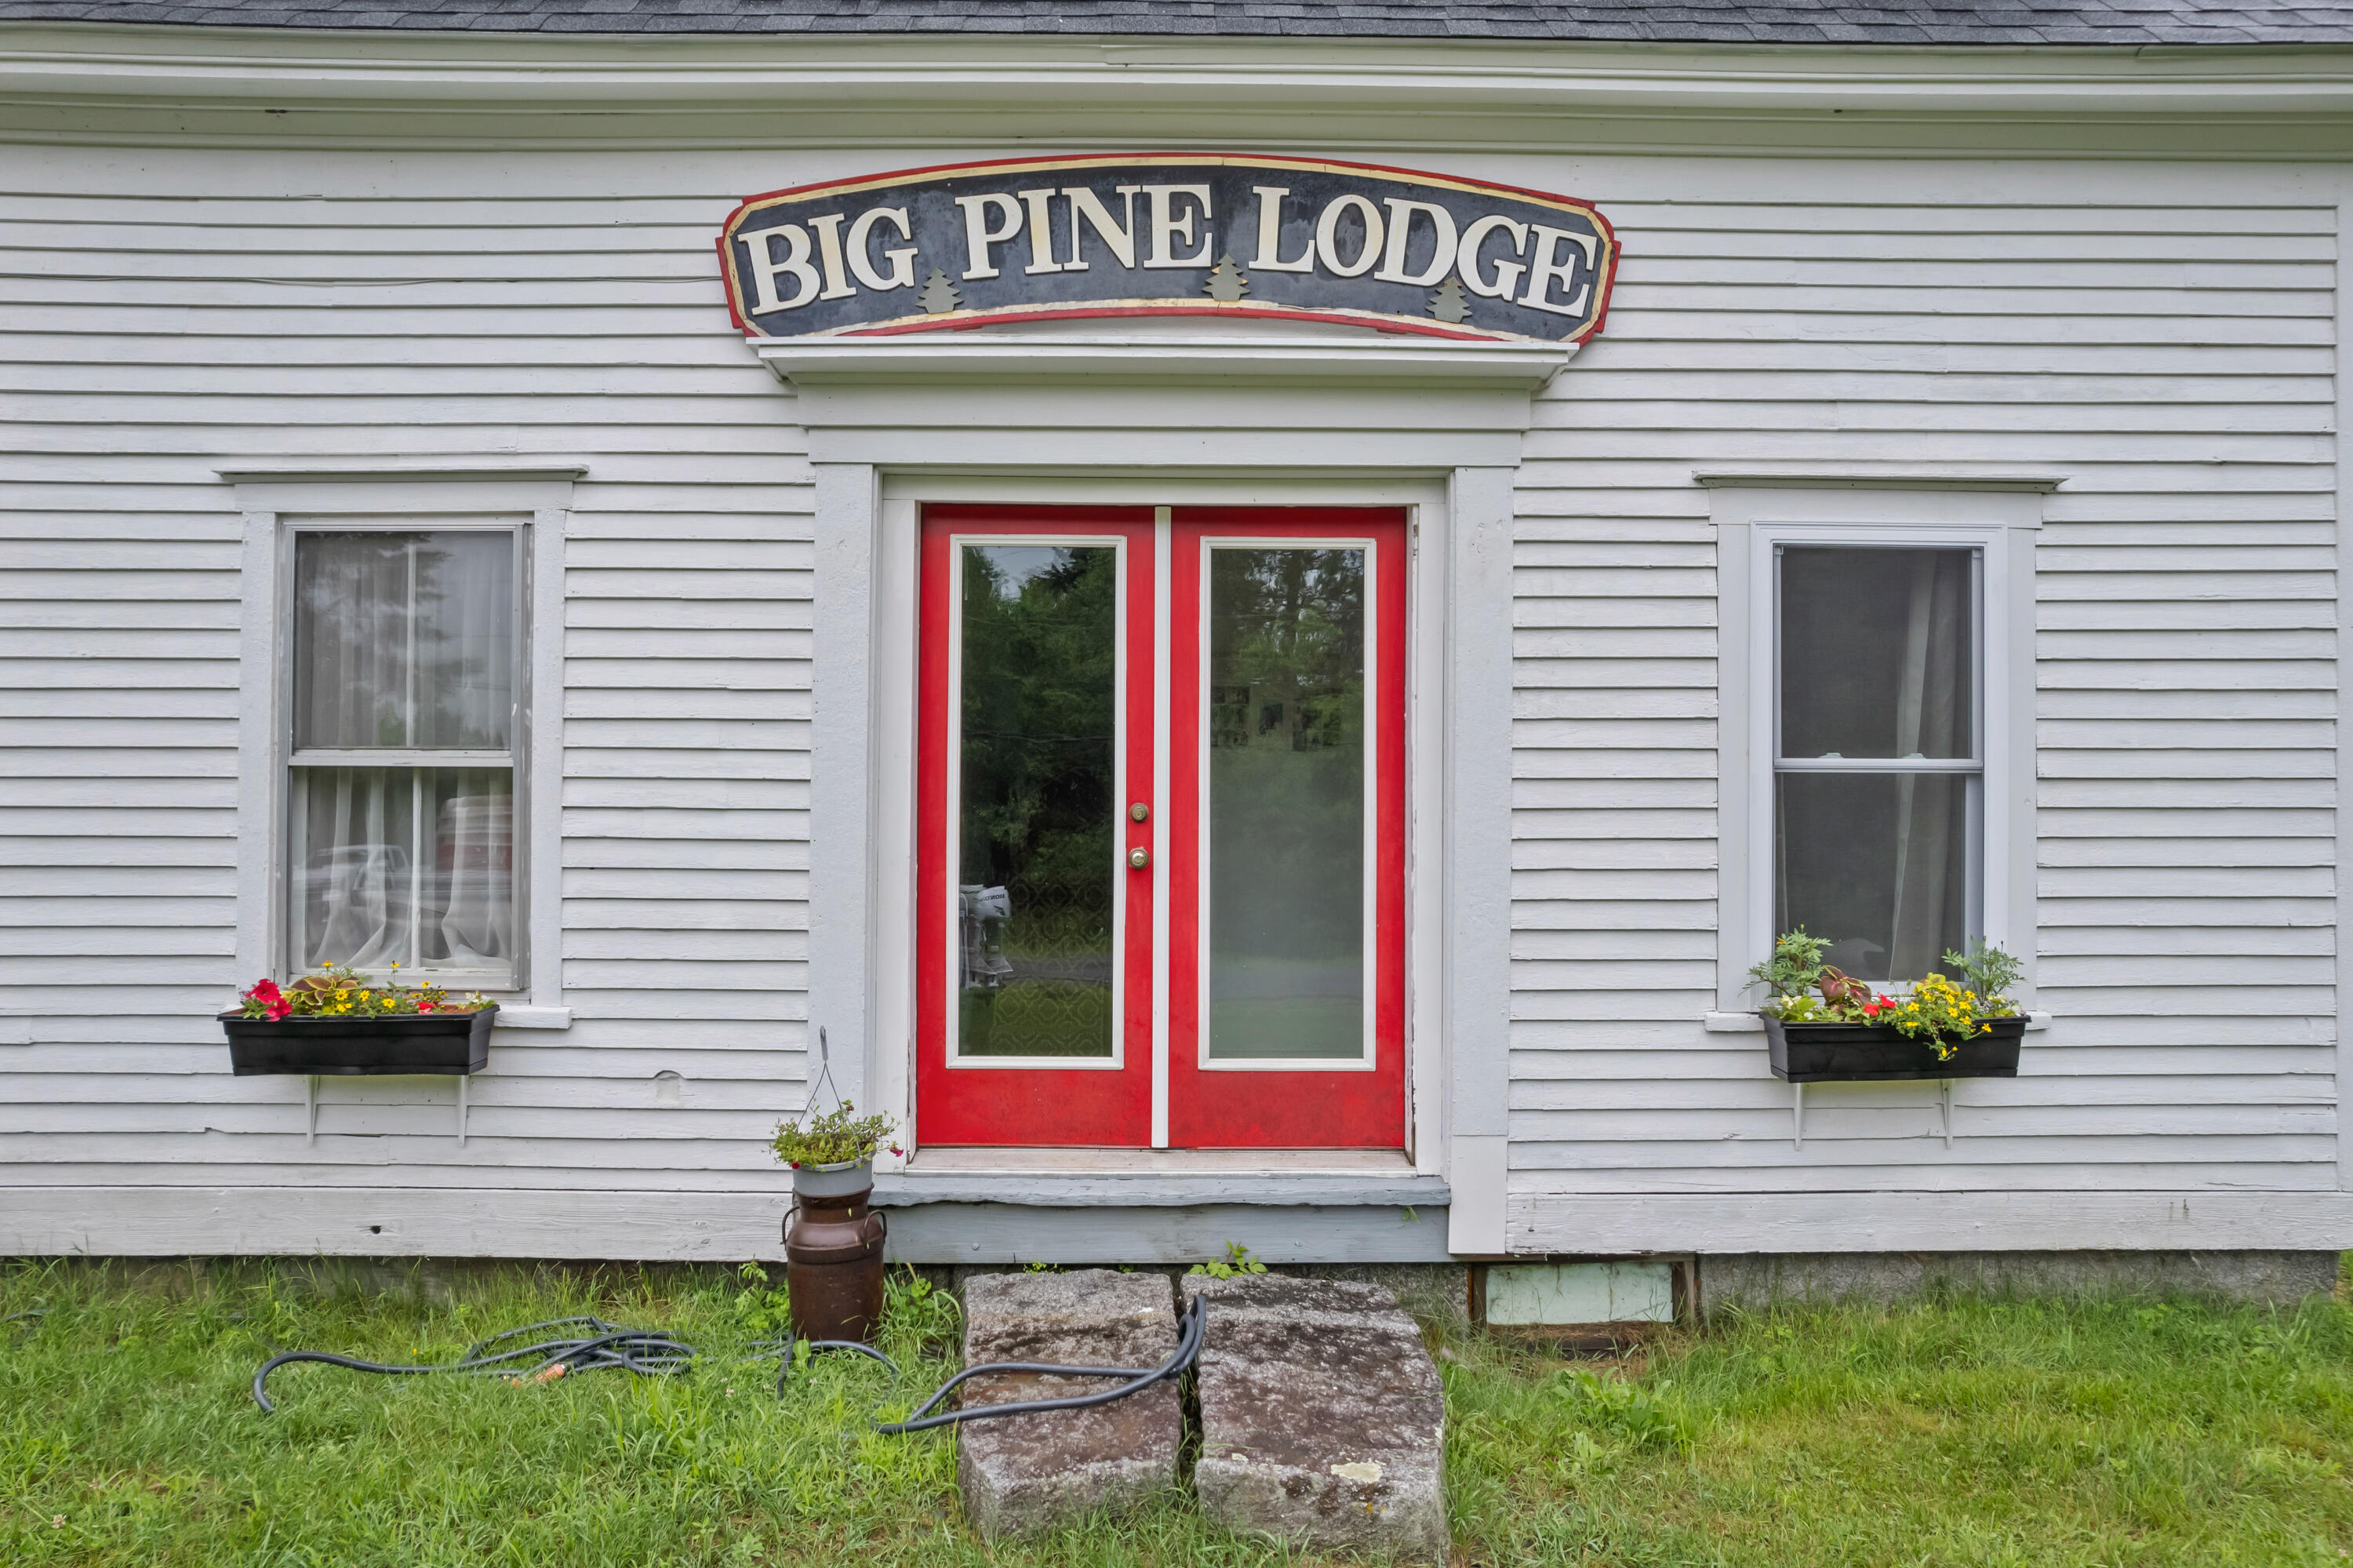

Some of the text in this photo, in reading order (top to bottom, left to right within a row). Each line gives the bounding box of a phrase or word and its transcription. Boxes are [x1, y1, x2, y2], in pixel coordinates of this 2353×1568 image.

[737, 184, 1596, 318] BIG PINE LODGE
